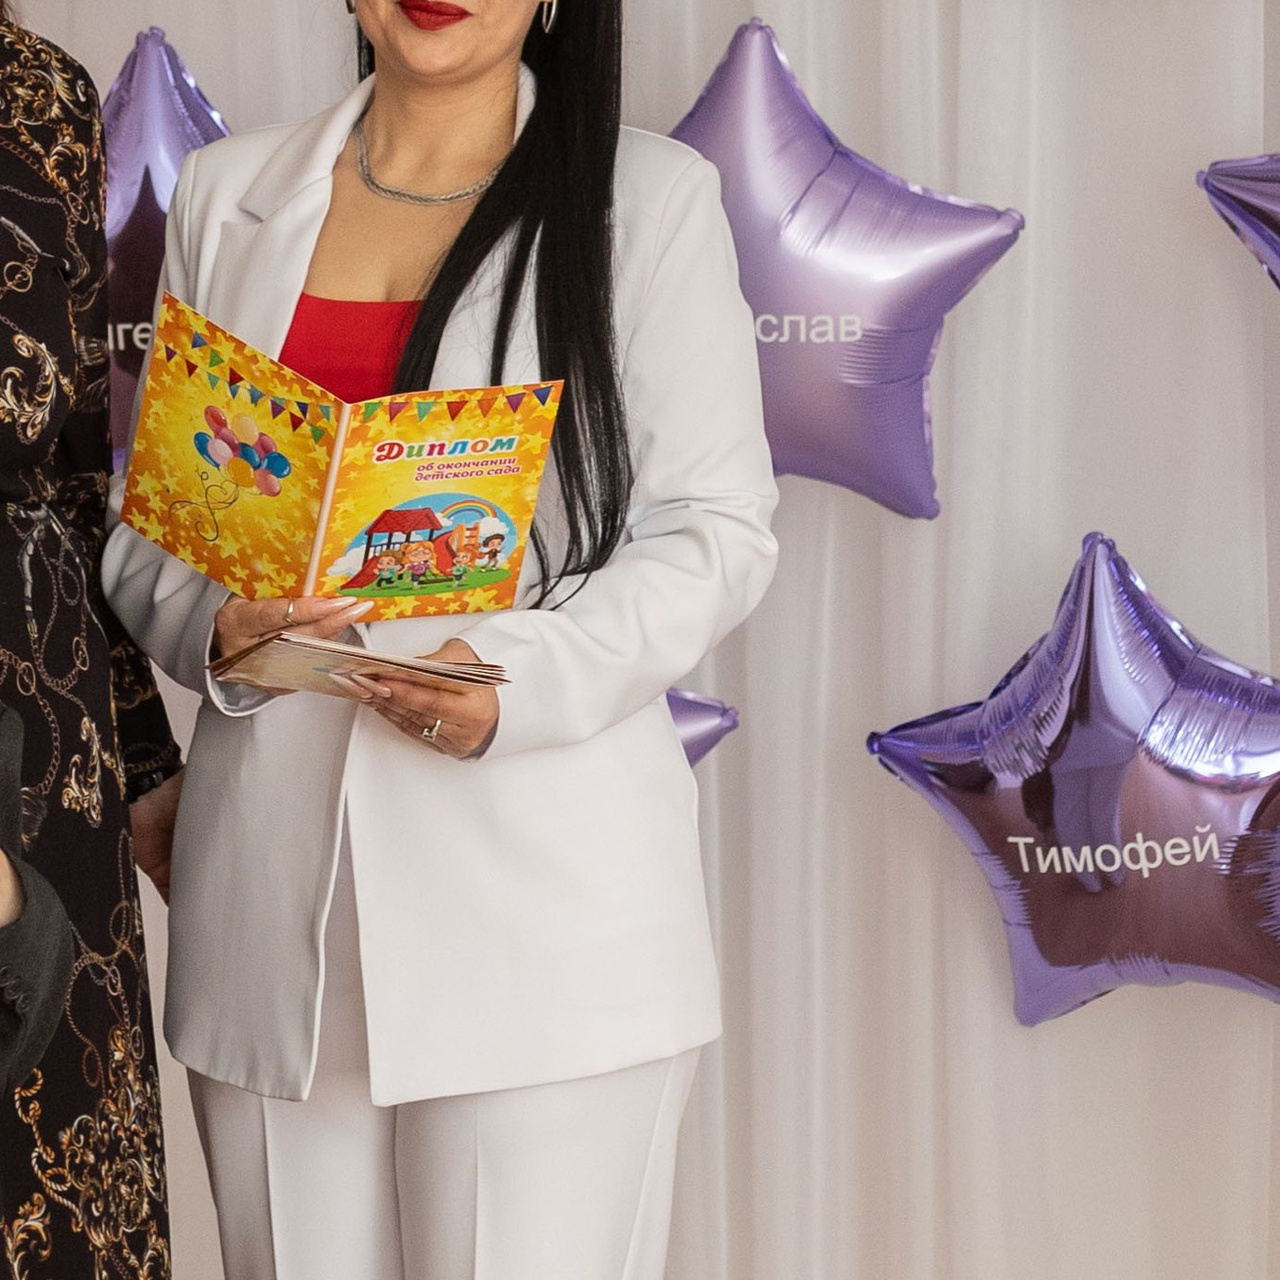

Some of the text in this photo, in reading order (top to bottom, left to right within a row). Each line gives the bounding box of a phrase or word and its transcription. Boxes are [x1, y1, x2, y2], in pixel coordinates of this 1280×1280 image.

[374, 436, 518, 462] Диплом
[415, 465, 521, 482] детского сада
[417, 457, 516, 472] об окончании
[1006, 823, 1221, 879] Тимофей
